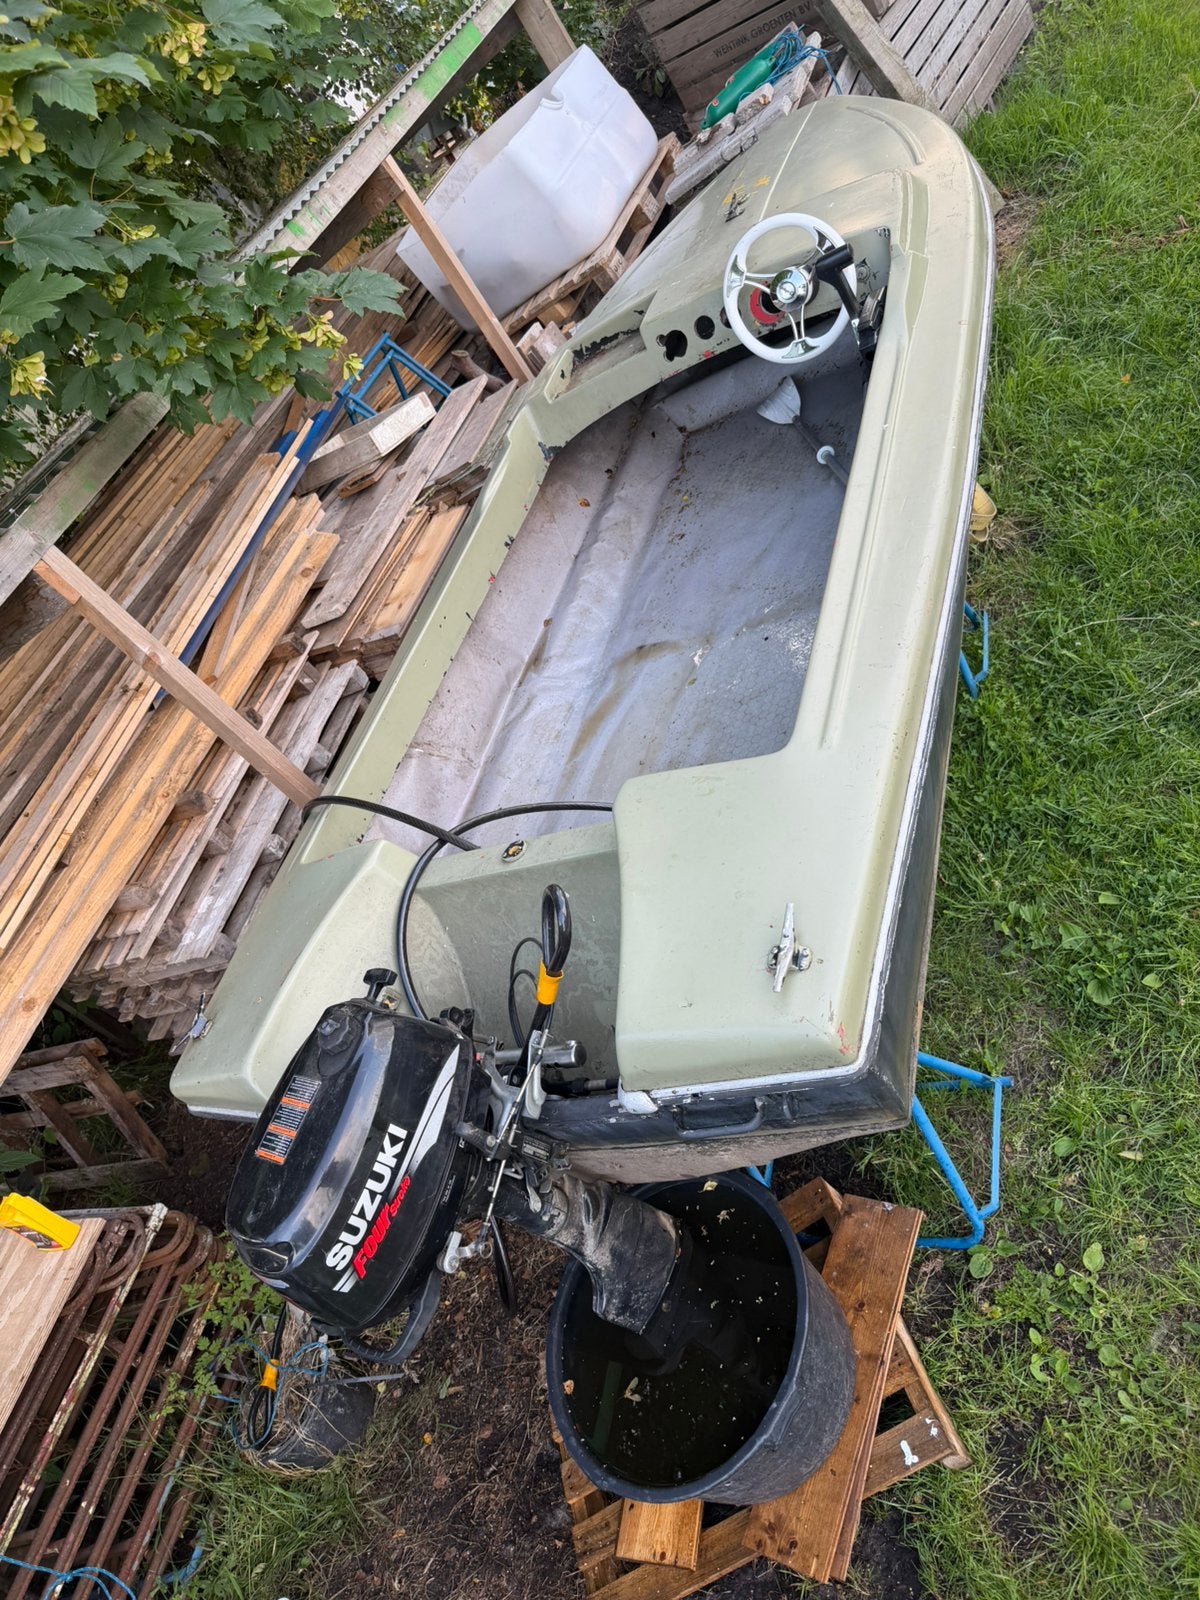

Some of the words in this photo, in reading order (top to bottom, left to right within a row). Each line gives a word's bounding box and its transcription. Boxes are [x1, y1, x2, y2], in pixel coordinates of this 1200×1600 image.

[751, 10, 797, 38] GROENTEN
[798, 2, 811, 15] BV
[325, 1123, 408, 1271] SUZUKI
